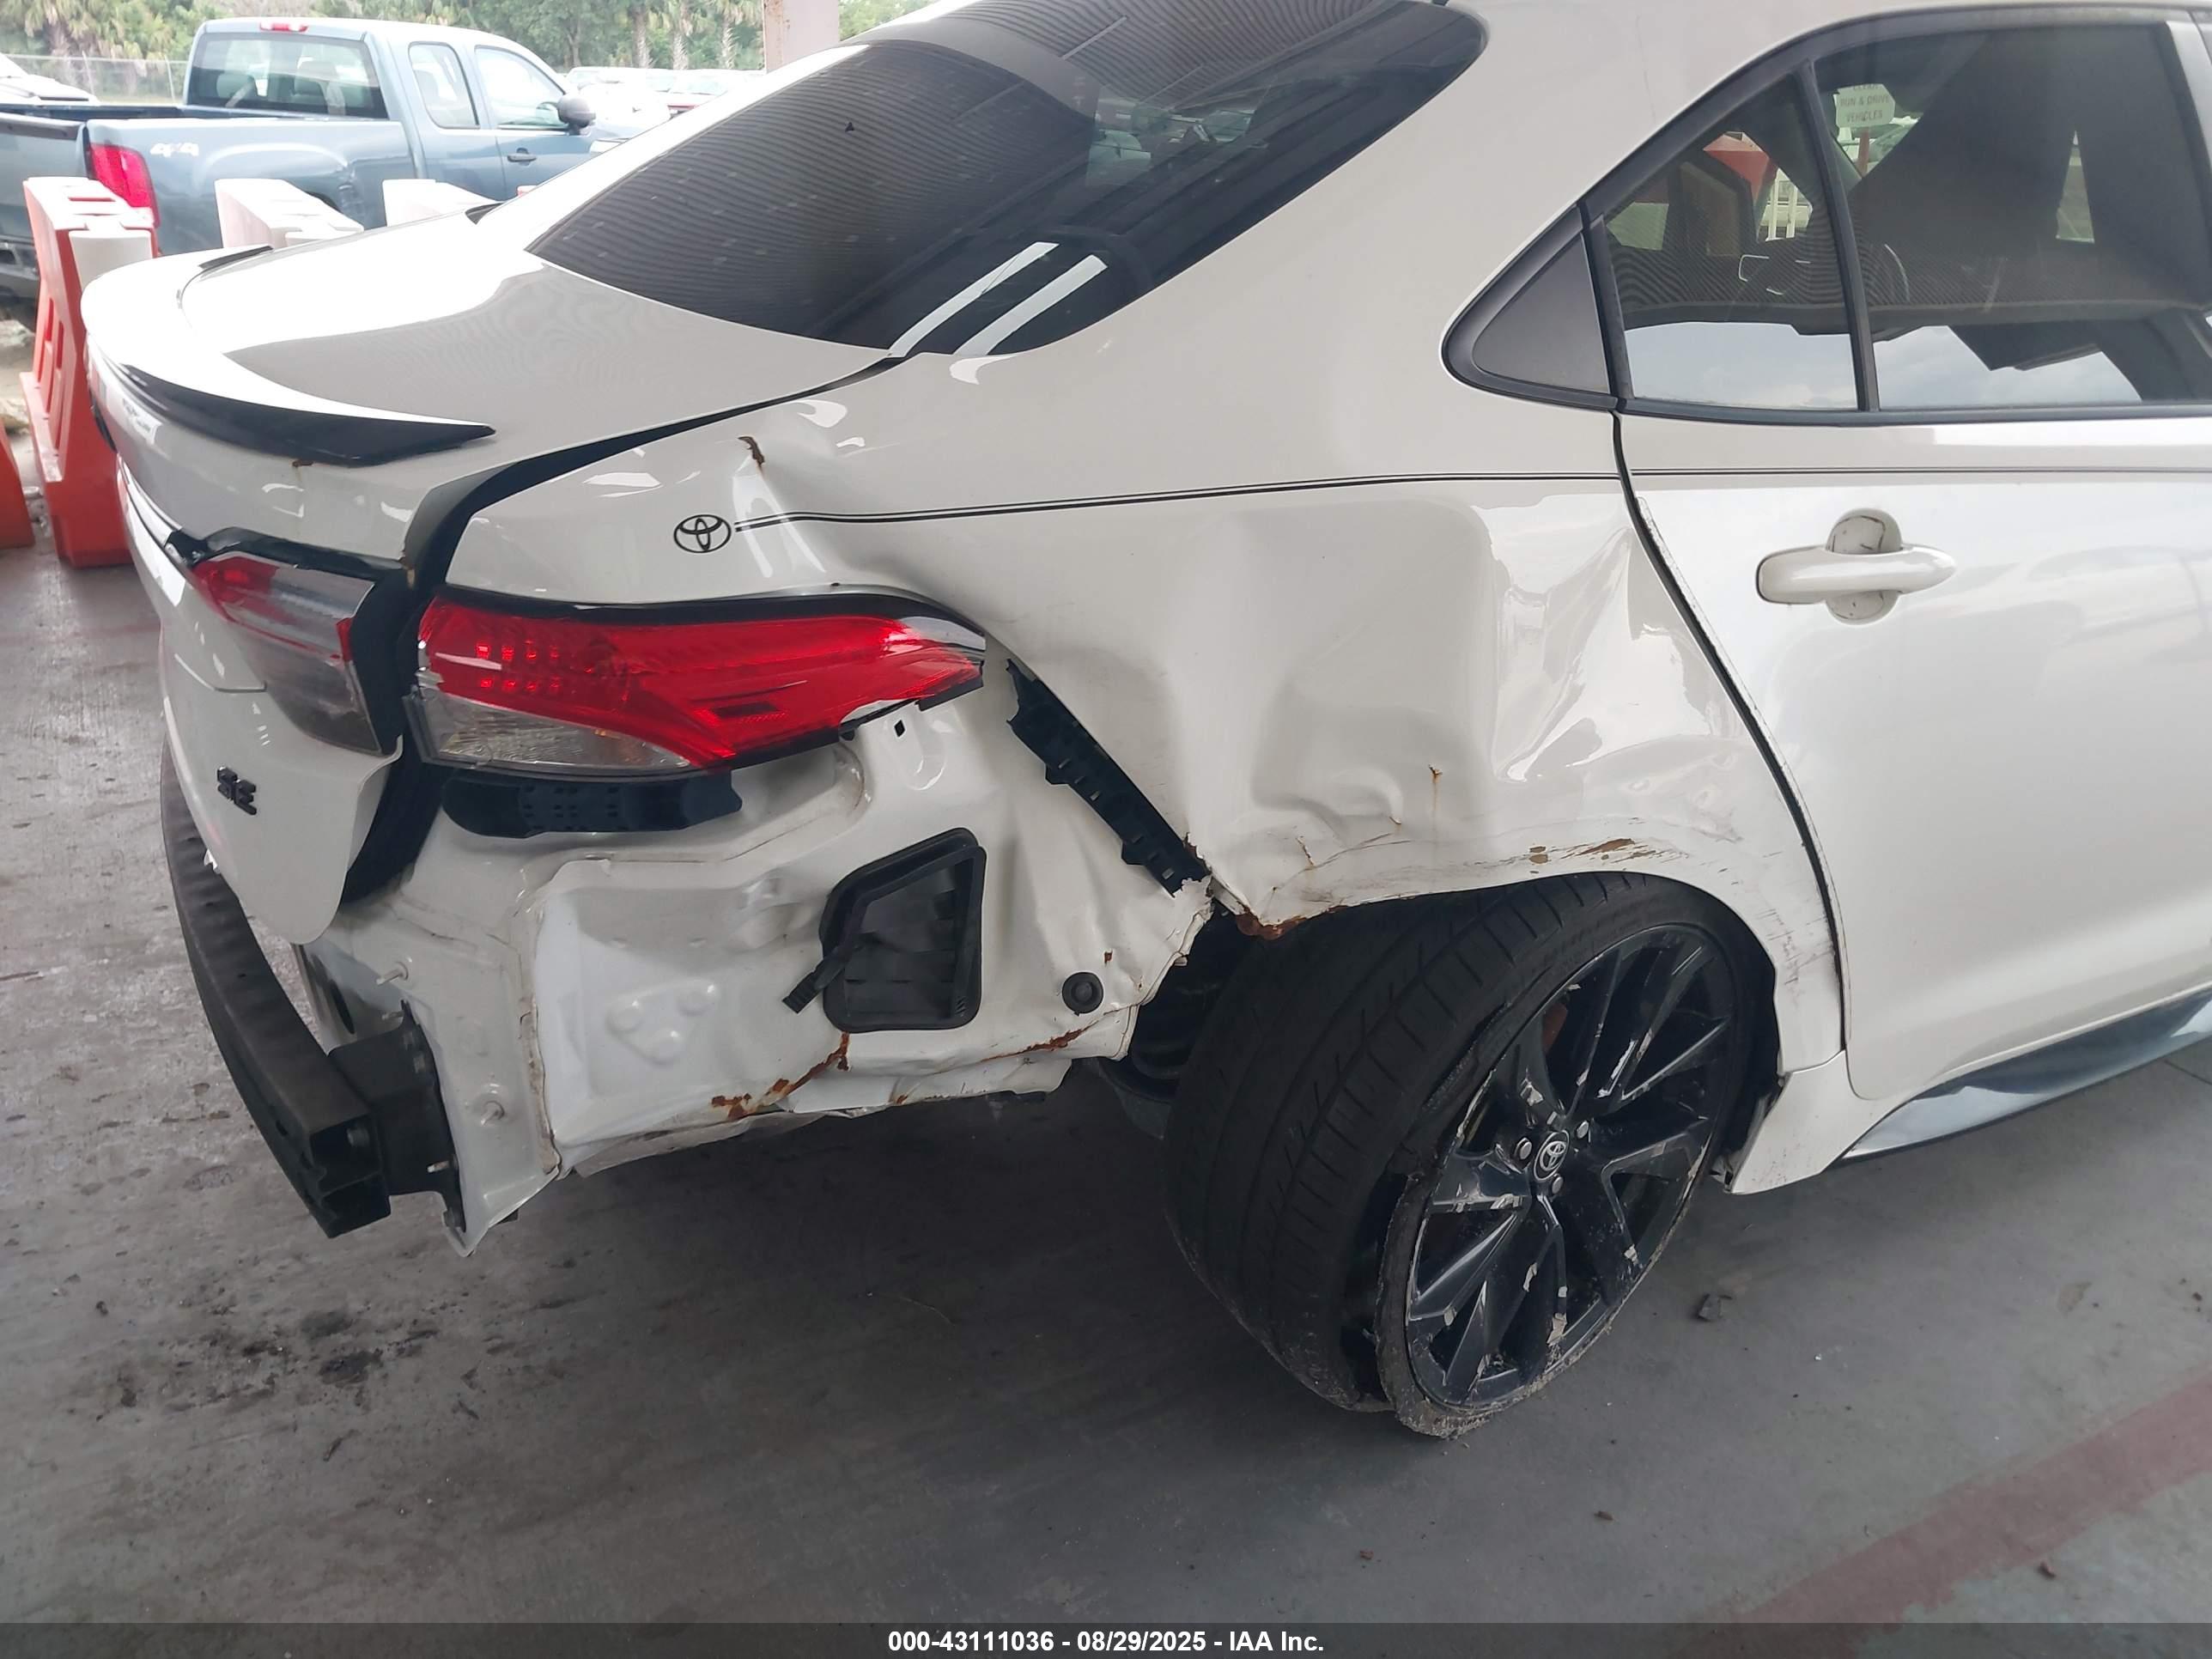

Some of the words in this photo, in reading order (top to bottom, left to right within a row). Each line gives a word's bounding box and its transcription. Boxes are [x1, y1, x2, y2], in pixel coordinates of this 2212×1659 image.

[1840, 96, 1856, 107] RUN
[1859, 95, 1865, 106] &
[1846, 109, 1883, 123] VEHICLES
